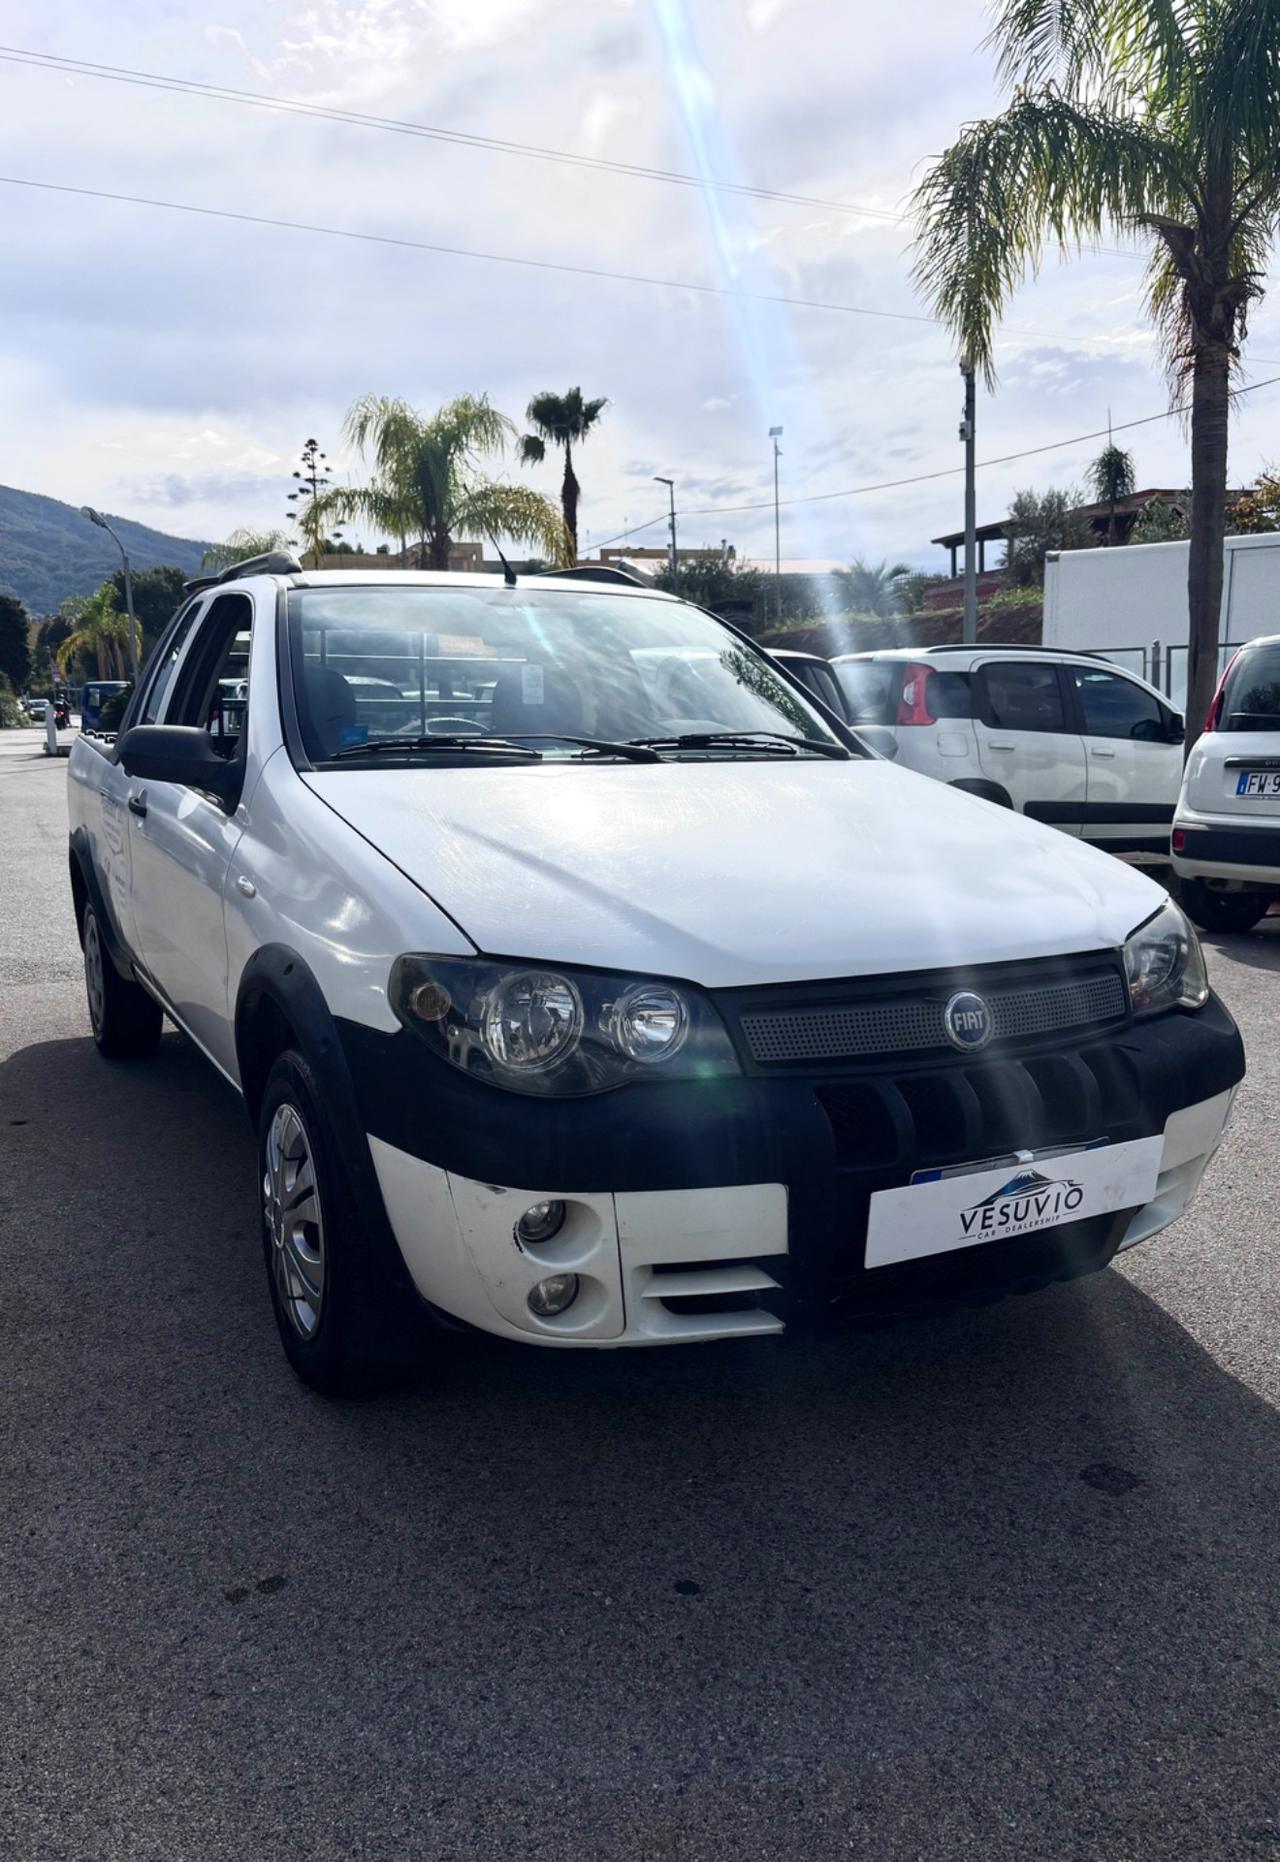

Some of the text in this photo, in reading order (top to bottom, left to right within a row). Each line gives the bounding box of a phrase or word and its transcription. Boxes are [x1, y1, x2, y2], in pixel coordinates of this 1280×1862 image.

[953, 1010, 983, 1032] FIAT
[960, 1187, 1083, 1235] VESUVIO
[977, 1215, 1060, 1240] CAR DEALERSHIP
